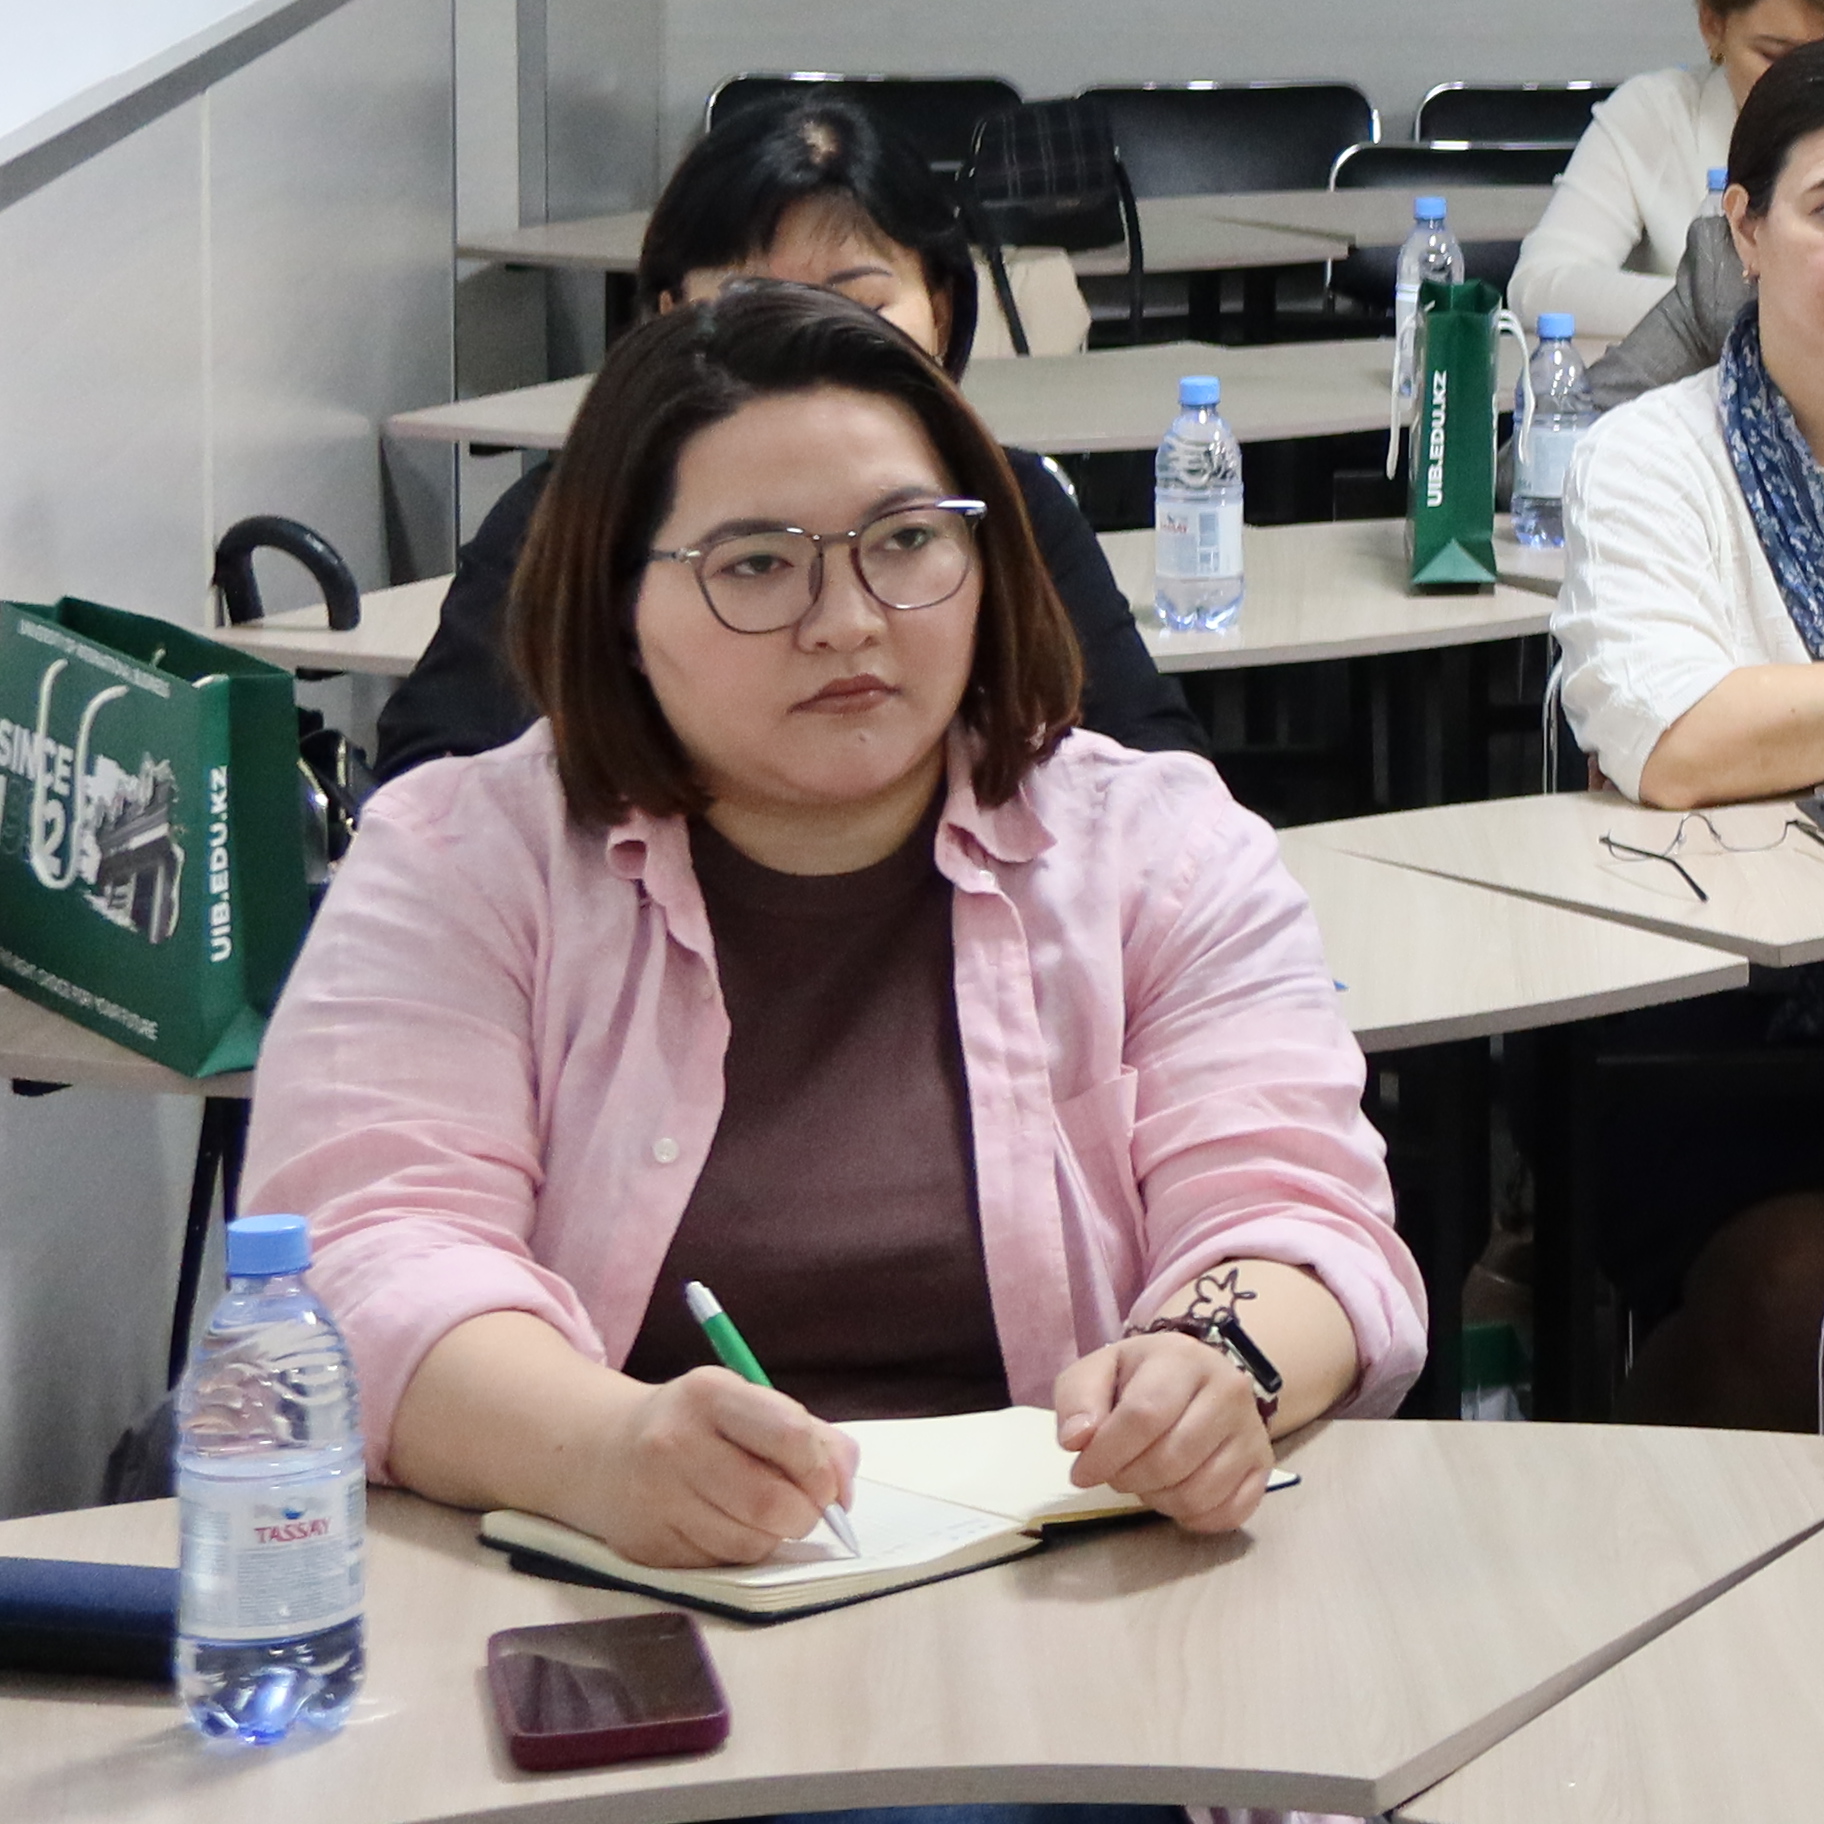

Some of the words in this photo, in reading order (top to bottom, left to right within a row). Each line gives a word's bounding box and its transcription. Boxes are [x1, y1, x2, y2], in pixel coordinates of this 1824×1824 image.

[1427, 370, 1448, 507] UIB.EDU.KZ
[210, 765, 232, 962] UIB.EDU.KZ
[253, 1518, 331, 1544] TASSAY
